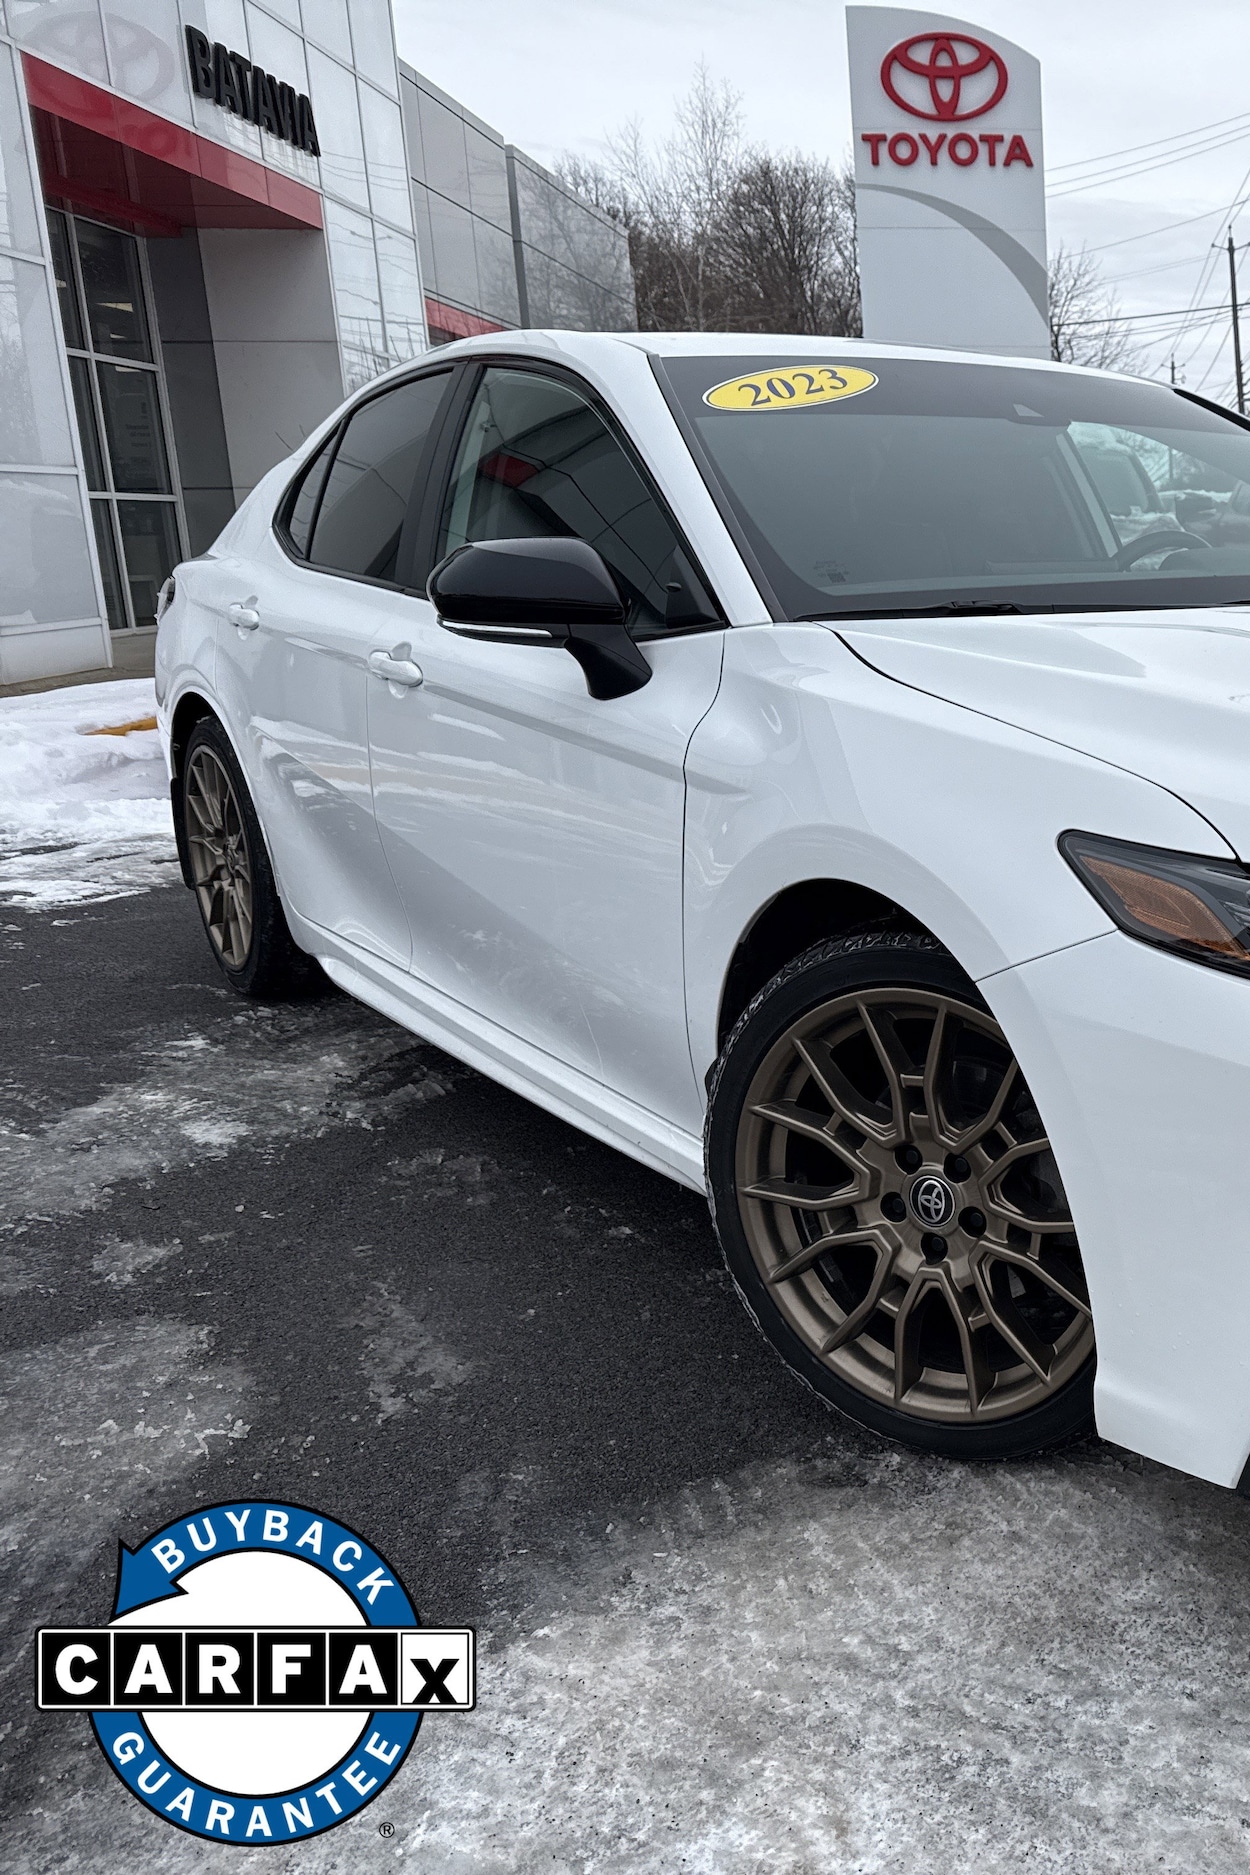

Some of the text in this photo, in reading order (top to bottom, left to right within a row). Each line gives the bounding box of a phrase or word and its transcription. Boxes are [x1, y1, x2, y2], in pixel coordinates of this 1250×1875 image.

[185, 24, 321, 157] BATAVIA
[861, 133, 1033, 168] TOYOTA
[738, 368, 848, 406] 2023
